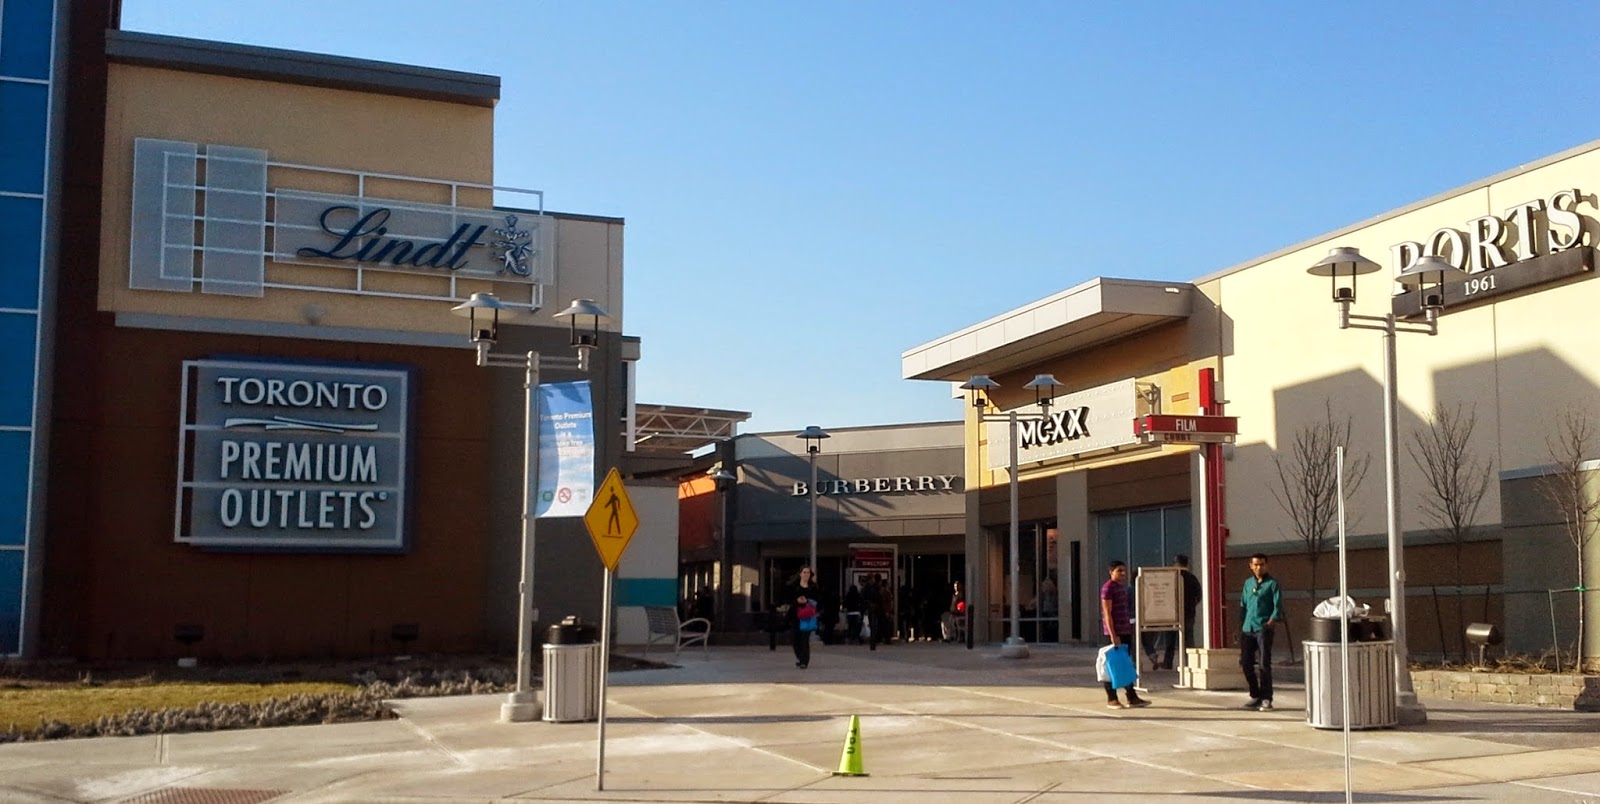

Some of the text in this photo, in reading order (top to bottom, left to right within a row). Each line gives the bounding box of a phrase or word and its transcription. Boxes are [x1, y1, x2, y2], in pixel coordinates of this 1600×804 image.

[297, 205, 489, 270] Lindt
[1389, 188, 1582, 296] PORTS
[1464, 275, 1496, 296] 1961
[217, 377, 388, 410] TORONTO
[1175, 418, 1197, 431] FILM
[221, 440, 378, 482] PREMIUM
[791, 474, 957, 496] BURBERRY
